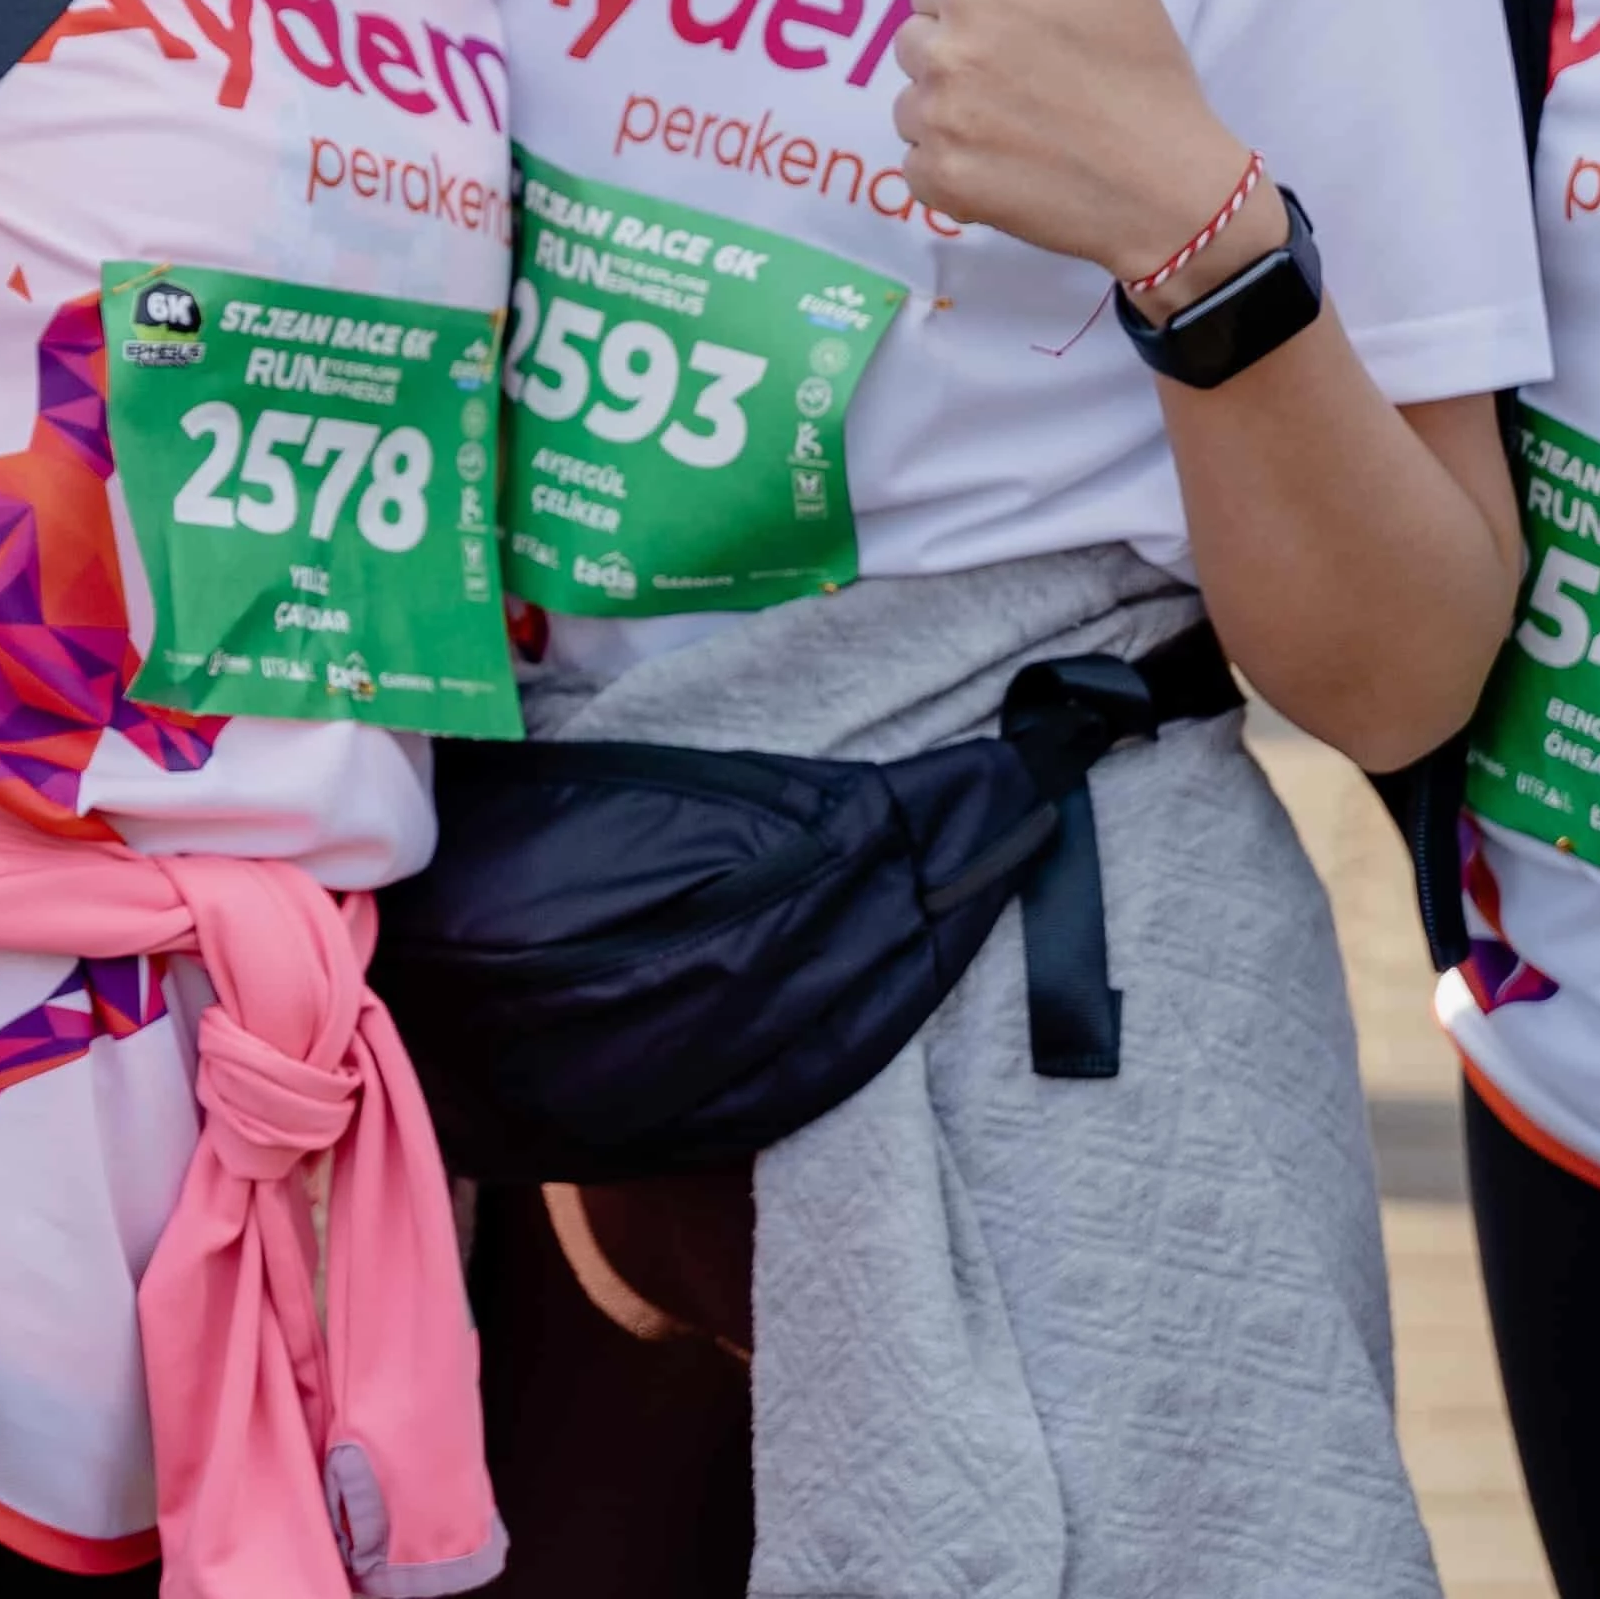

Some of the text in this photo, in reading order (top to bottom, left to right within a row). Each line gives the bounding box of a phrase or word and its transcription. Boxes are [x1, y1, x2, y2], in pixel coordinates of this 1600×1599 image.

[308, 135, 513, 250] peraken
[534, 229, 613, 288] RUN
[612, 216, 714, 266] RACE
[713, 244, 769, 281] 6K
[146, 291, 193, 327] 6K
[219, 300, 333, 345] ST.JEAN
[330, 316, 405, 357] RACE
[245, 346, 328, 395] RUN
[501, 277, 770, 468] 2593
[172, 400, 433, 553] 2578
